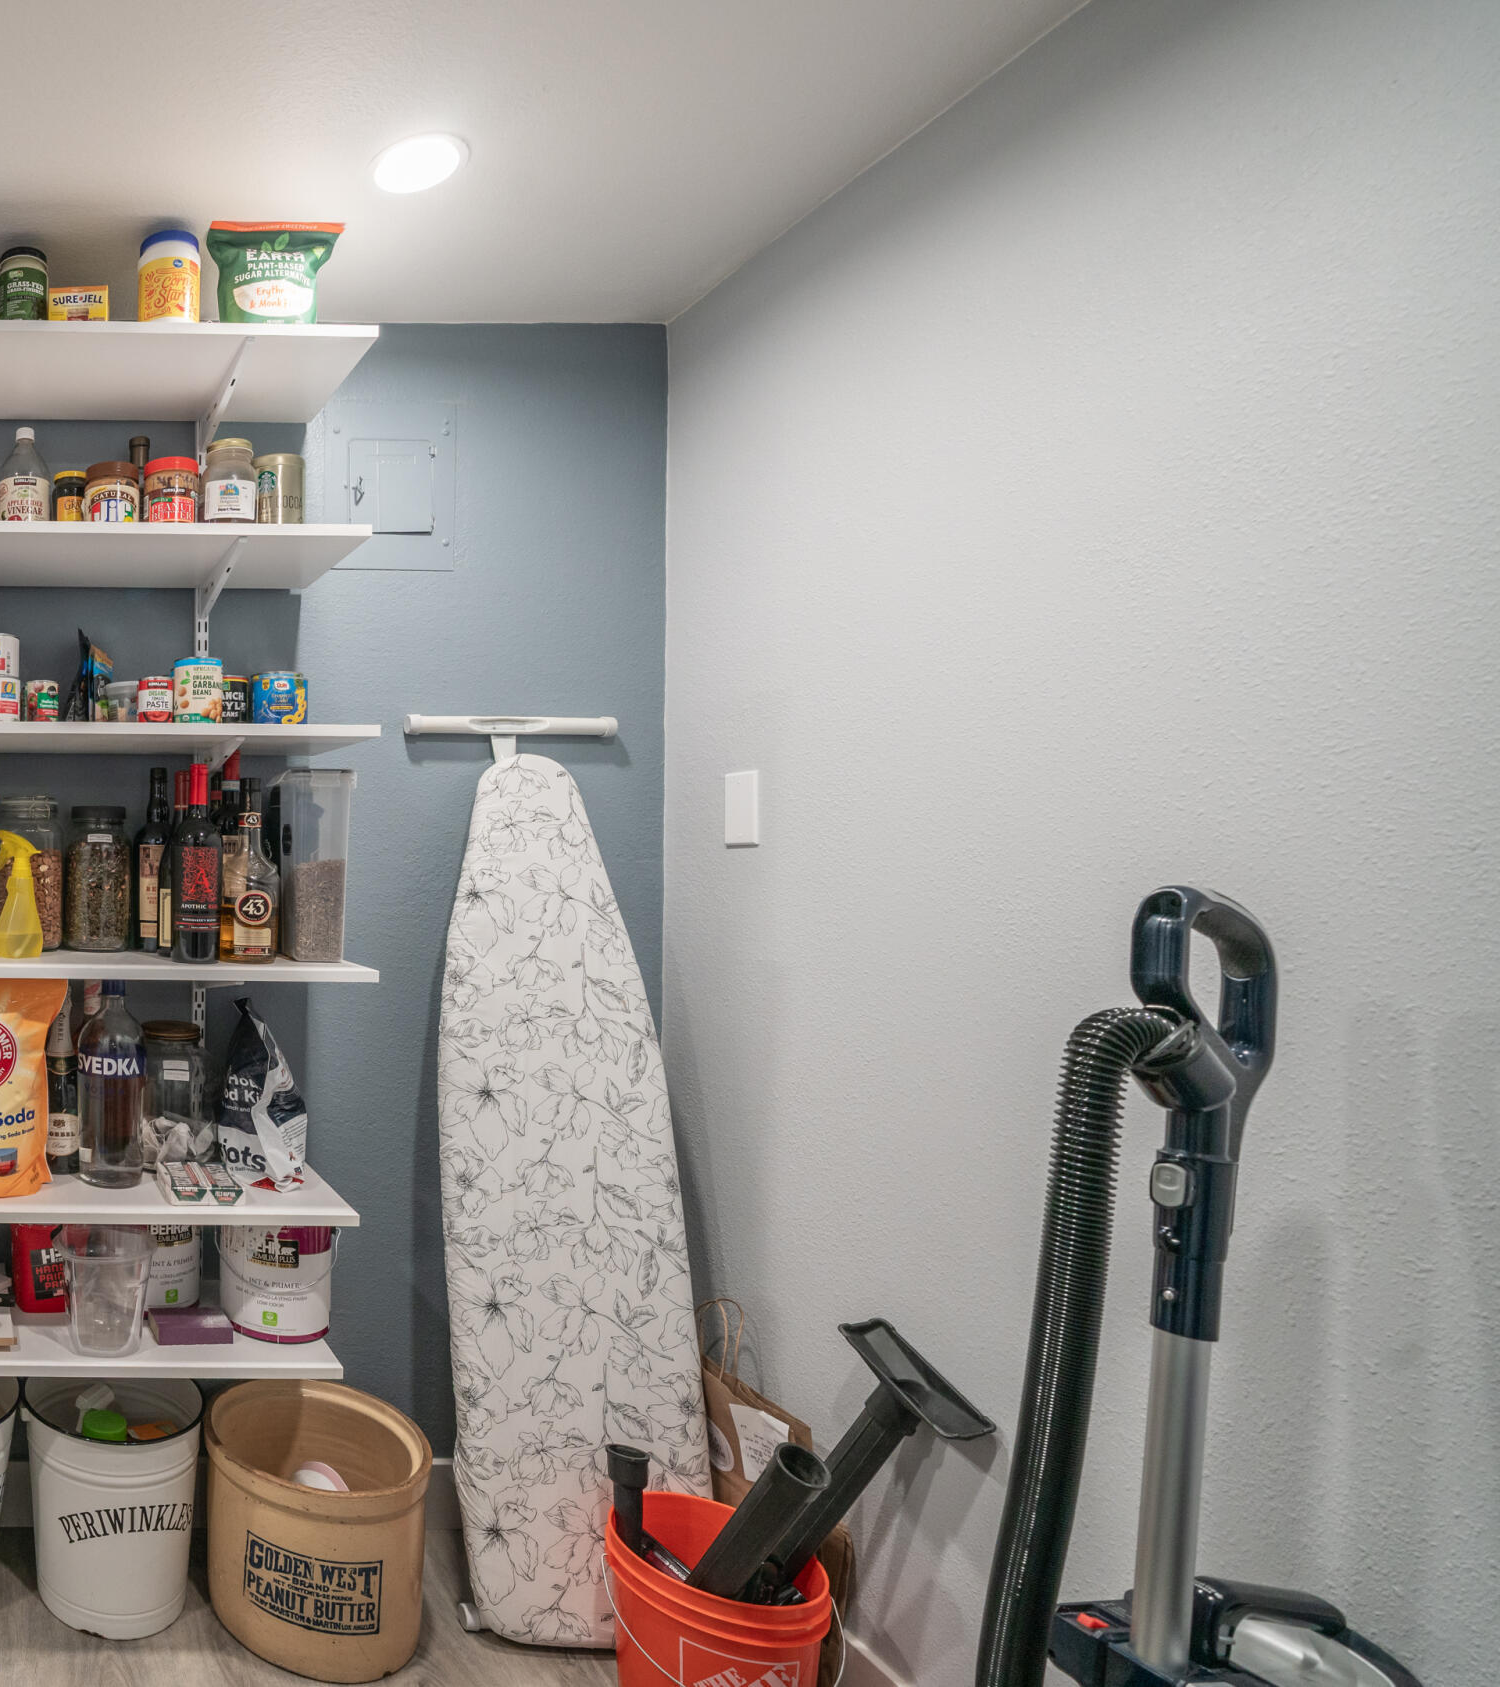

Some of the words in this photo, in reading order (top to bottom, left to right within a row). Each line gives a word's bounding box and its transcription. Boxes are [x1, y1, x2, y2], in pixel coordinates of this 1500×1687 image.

[246, 248, 306, 262] EARTH
[247, 262, 304, 272] PLANT-BASED
[234, 270, 262, 284] SUGAR
[264, 269, 311, 287] ALTERNATIVE
[6, 280, 44, 291] GRASS-FED
[92, 490, 135, 502] NATURAL
[7, 499, 24, 507] APPLE
[151, 502, 193, 512] PEANUT
[7, 505, 44, 516] VINEGAR
[92, 499, 134, 522] Jif
[151, 511, 193, 520] BUTTER
[192, 680, 222, 690] GARBAN
[221, 691, 245, 701] ANCH
[146, 701, 170, 709] PASTE
[222, 701, 247, 711] YLE
[247, 815, 258, 824] 43
[242, 898, 266, 916] 43
[77, 1053, 141, 1077] SVEDKA
[7, 1131, 21, 1139] Soda
[21, 1126, 36, 1135] Brand
[279, 1254, 296, 1263] PLUS
[271, 1281, 301, 1289] PRIMER
[57, 1502, 193, 1544] PERIWINKLES
[248, 1538, 315, 1581] GOLDEN
[319, 1564, 379, 1600] WEST
[273, 1578, 286, 1587] NET
[331, 1593, 354, 1602] POUNDS
[291, 1577, 330, 1593] BRAND
[246, 1568, 309, 1615] PEANUT
[313, 1599, 376, 1623] BUTTER
[268, 1602, 306, 1623] MARSTON
[312, 1616, 342, 1631] MARTIN
[352, 1623, 375, 1631] ANGELES
